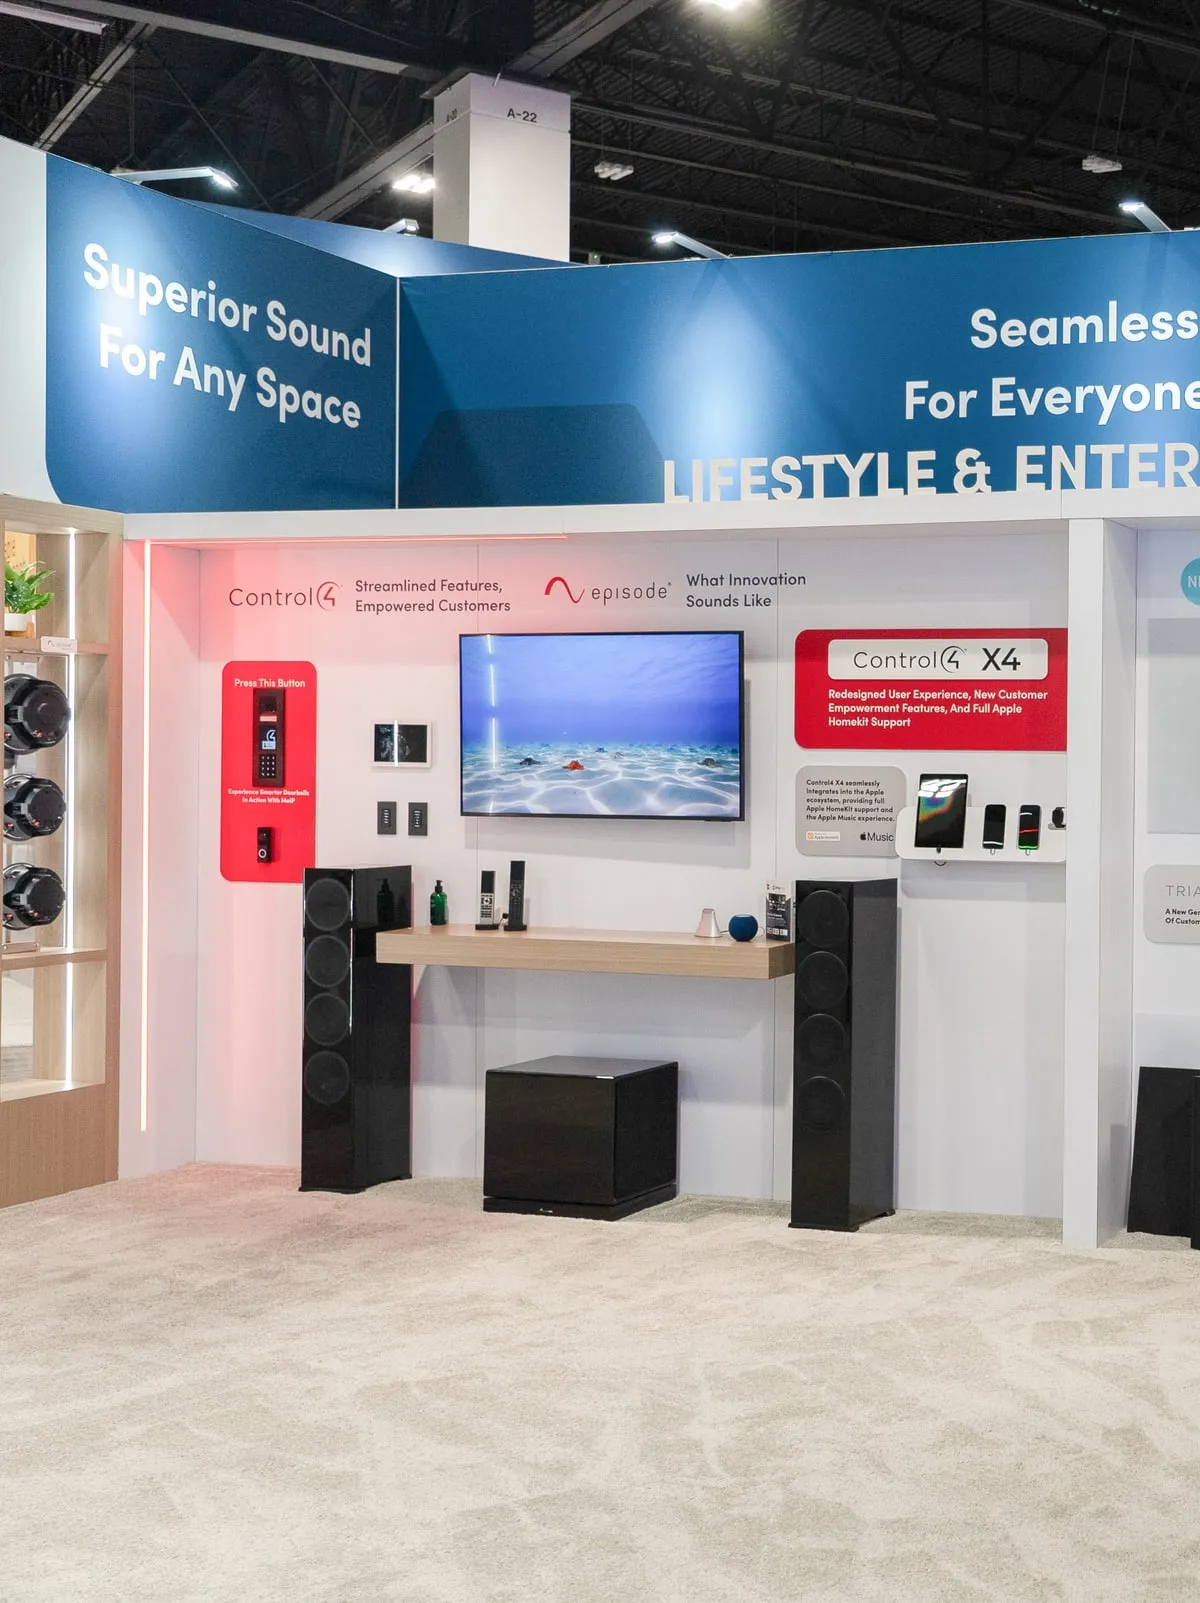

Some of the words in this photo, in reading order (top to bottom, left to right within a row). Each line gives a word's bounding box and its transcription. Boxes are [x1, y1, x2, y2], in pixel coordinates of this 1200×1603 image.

[506, 107, 537, 123] A-22
[83, 243, 257, 332] Superior
[266, 300, 371, 367] Sound
[970, 300, 1199, 349] Seamless
[100, 323, 166, 380] For
[173, 346, 247, 412] Any
[256, 366, 361, 428] Space
[905, 380, 978, 420] For
[663, 450, 937, 504] LIFESTYLE
[952, 448, 992, 495] &
[355, 579, 436, 592] Streamlined
[441, 579, 502, 593] Features,
[686, 573, 725, 586] What
[729, 573, 806, 586] Innovation
[591, 582, 667, 605] episode
[686, 594, 739, 607] Sounds
[744, 594, 771, 607] Like
[355, 600, 434, 615] Empowered
[439, 599, 511, 612] Customers
[981, 647, 1021, 671] X4
[234, 678, 257, 687] Press
[259, 678, 276, 687] This
[278, 678, 305, 687] Button
[828, 689, 886, 701] Redesigned
[888, 689, 911, 699] User
[913, 689, 971, 702] Experience,
[974, 689, 995, 699] New
[998, 689, 1048, 700] Customer
[828, 703, 899, 715] Empowerment
[902, 703, 948, 715] Features,
[950, 703, 970, 713] And
[972, 703, 990, 713] Full
[992, 703, 1022, 716] Apple
[828, 717, 868, 727] Homekit
[871, 717, 910, 729] Support
[845, 779, 880, 787] seamlessly
[867, 832, 894, 842] Music
